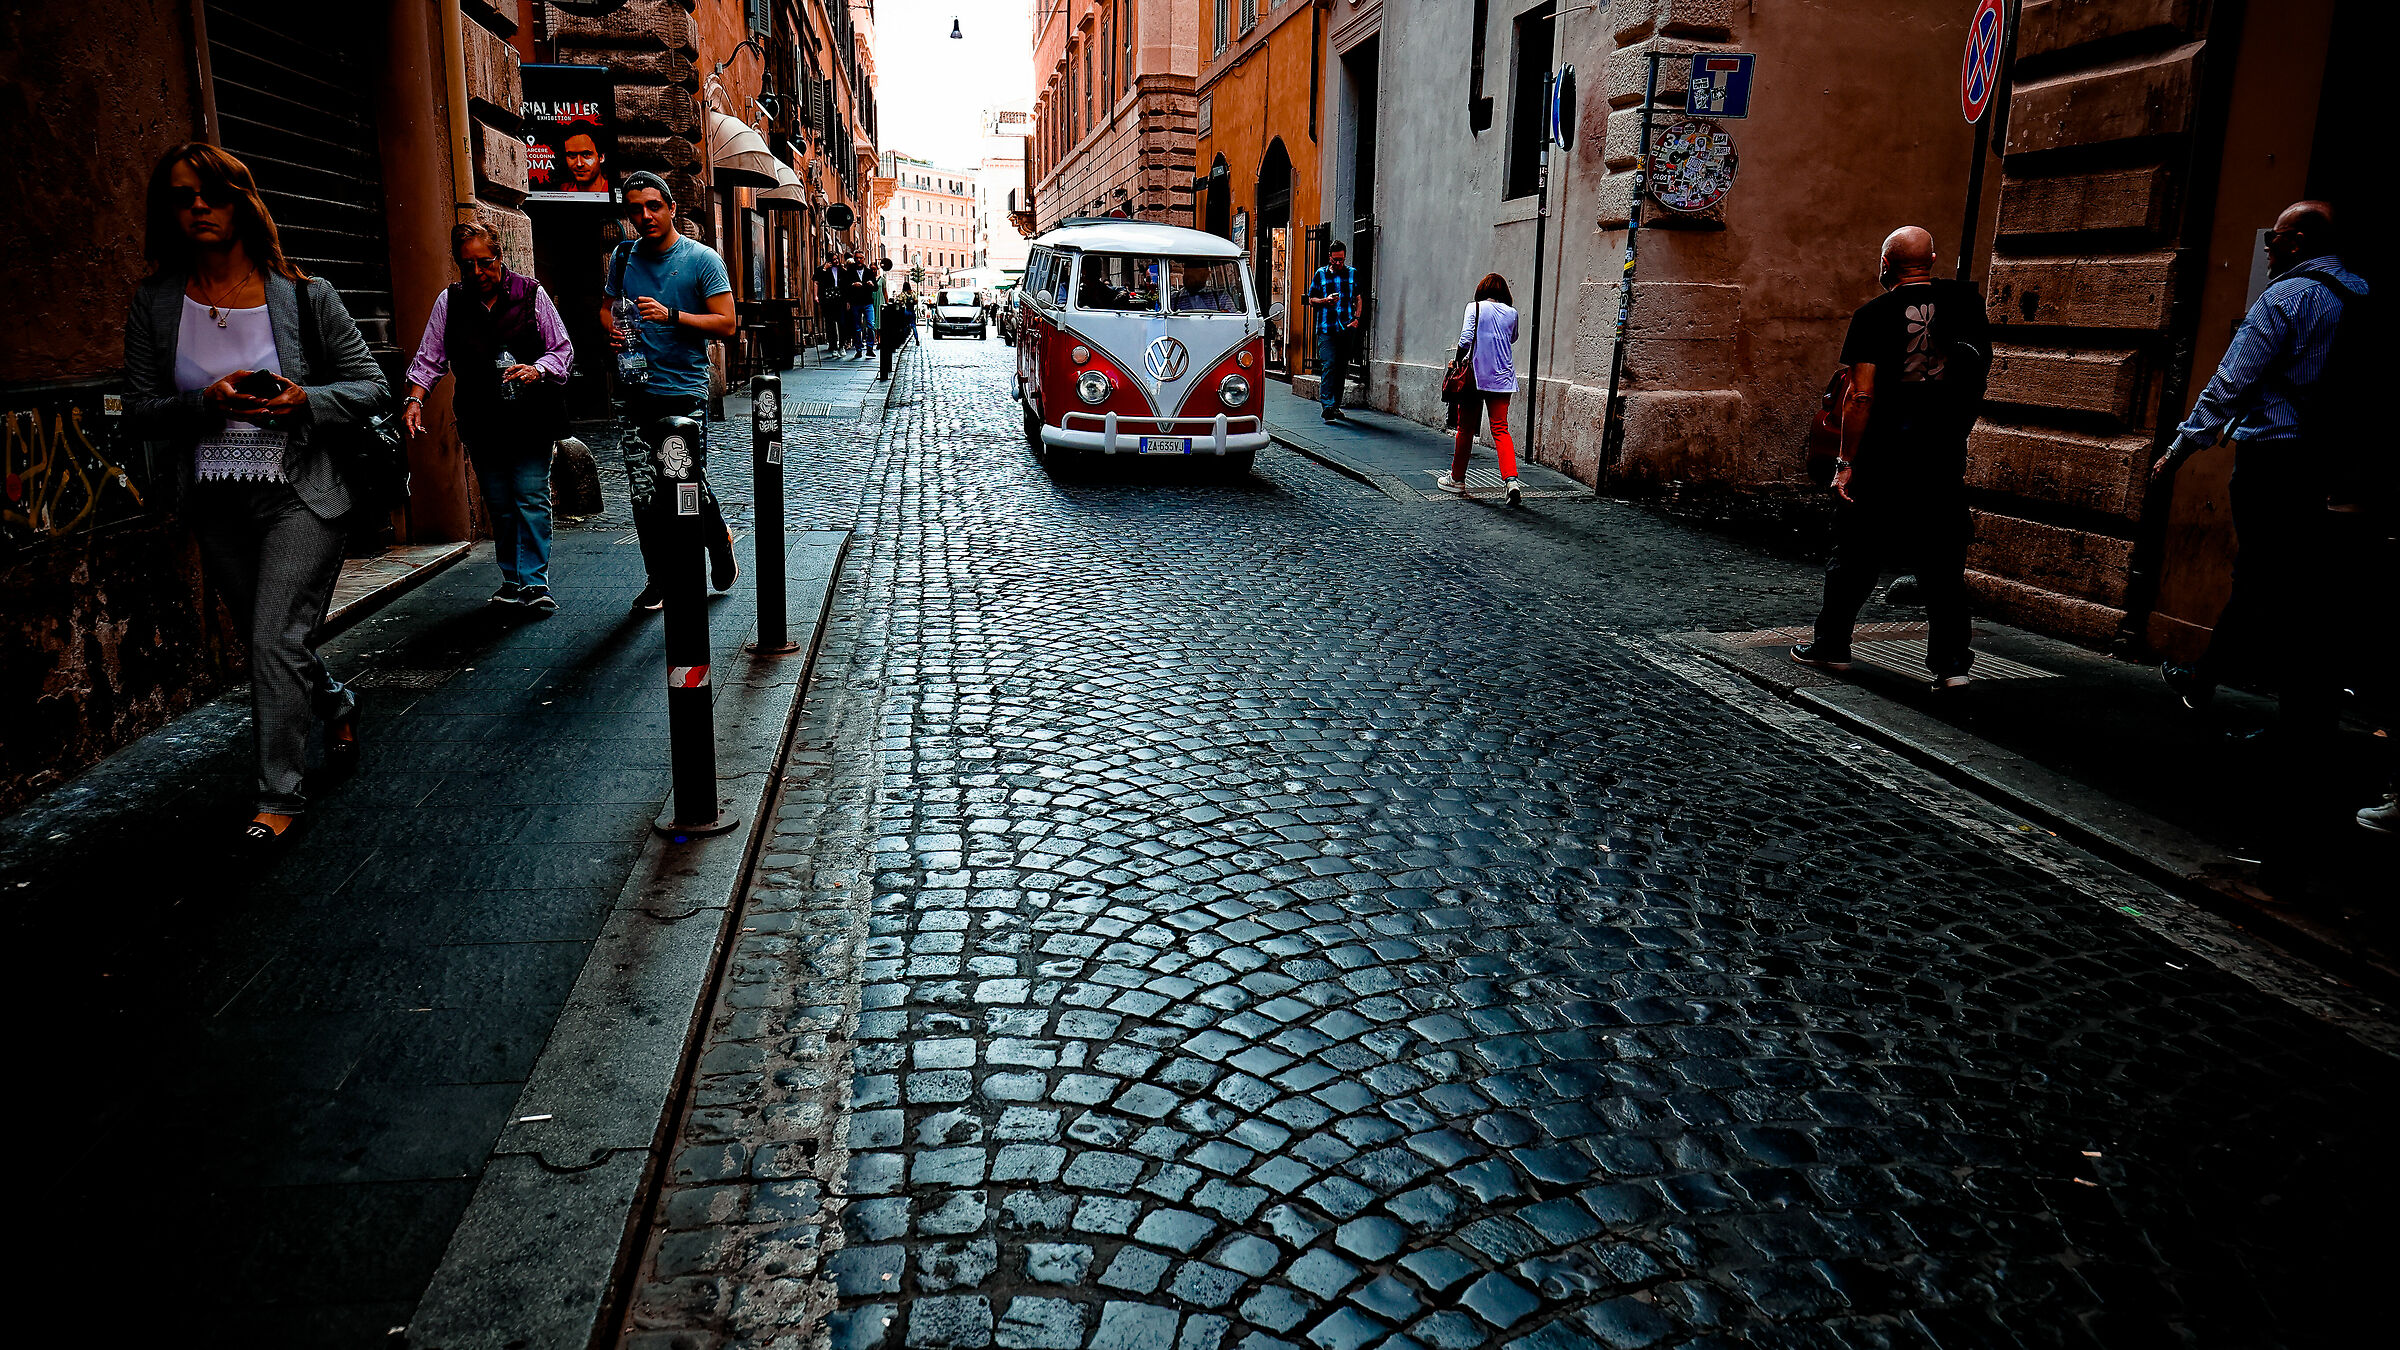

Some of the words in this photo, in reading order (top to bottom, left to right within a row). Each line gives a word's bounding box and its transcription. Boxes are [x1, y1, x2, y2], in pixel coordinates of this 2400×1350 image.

[521, 101, 551, 116] RIAL
[553, 101, 600, 116] KILLER
[526, 159, 556, 170] OMA
